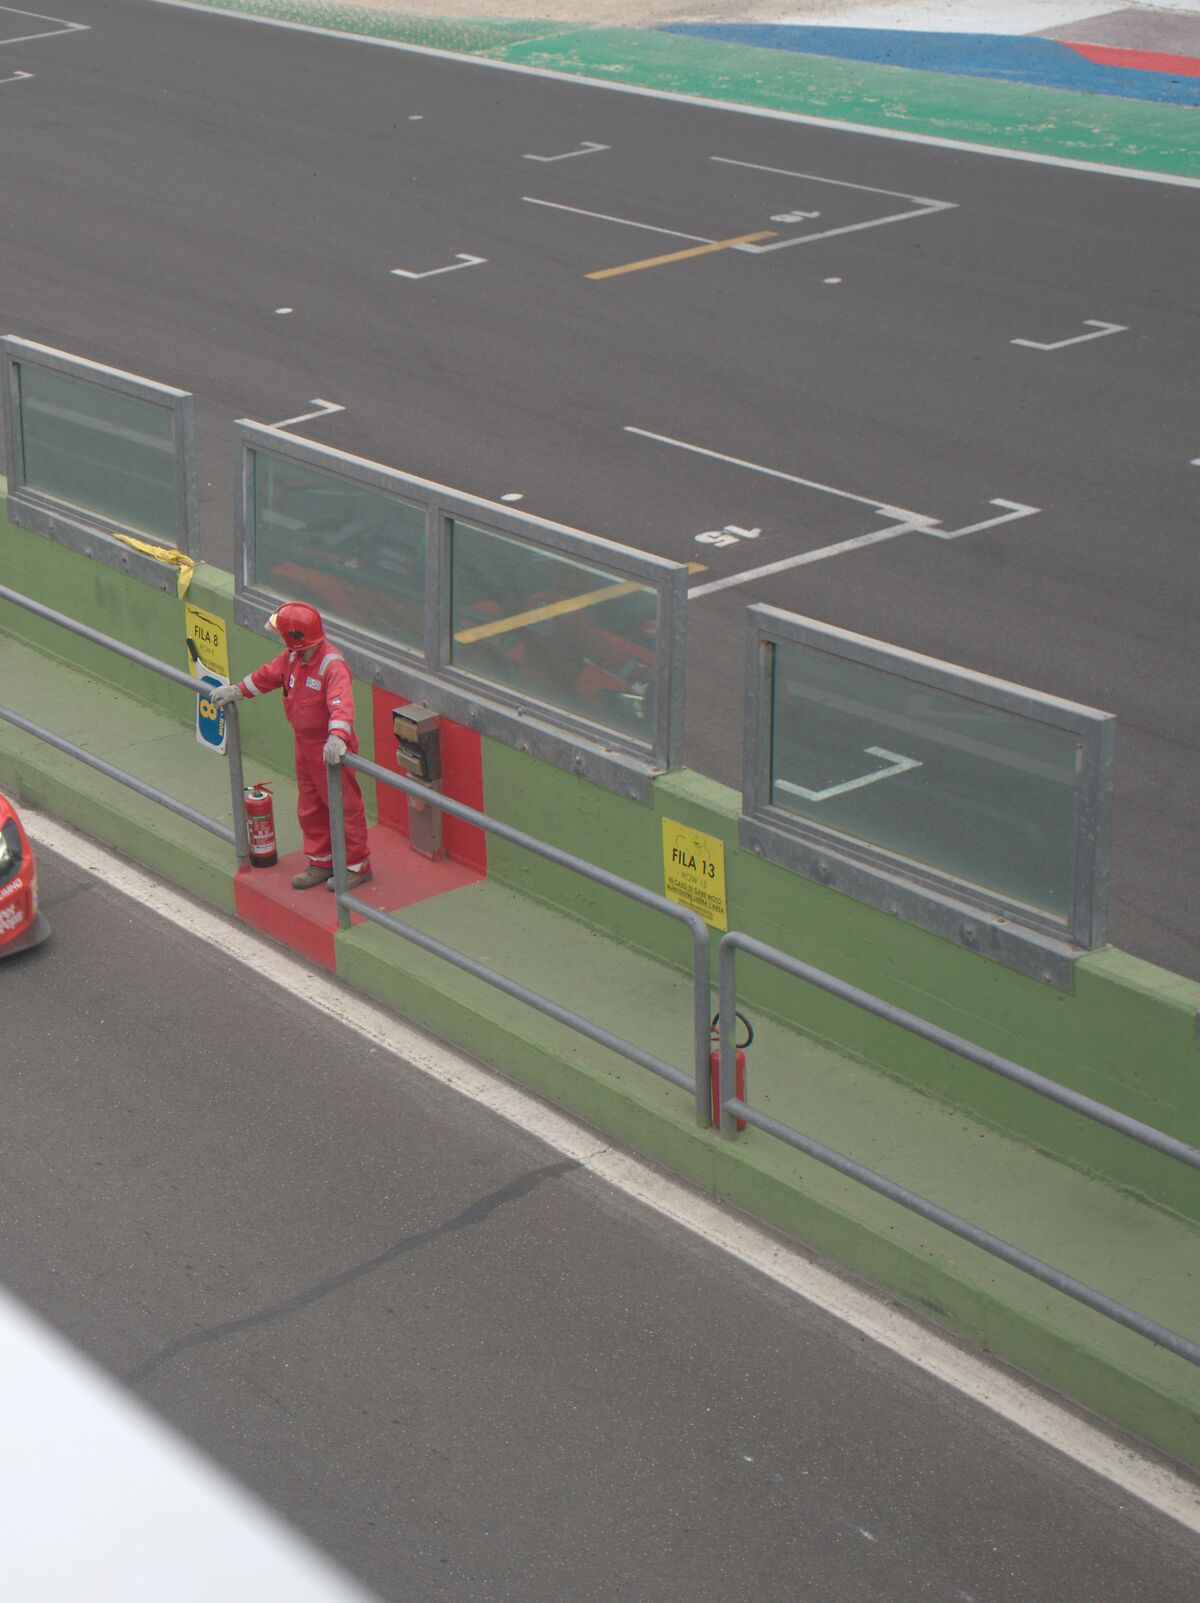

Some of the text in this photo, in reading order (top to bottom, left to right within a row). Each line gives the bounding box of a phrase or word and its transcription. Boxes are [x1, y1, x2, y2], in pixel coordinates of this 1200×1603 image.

[693, 524, 762, 548] 15
[194, 625, 219, 647] FILA 8
[200, 699, 217, 721] 8
[672, 847, 716, 879] FILA 13
